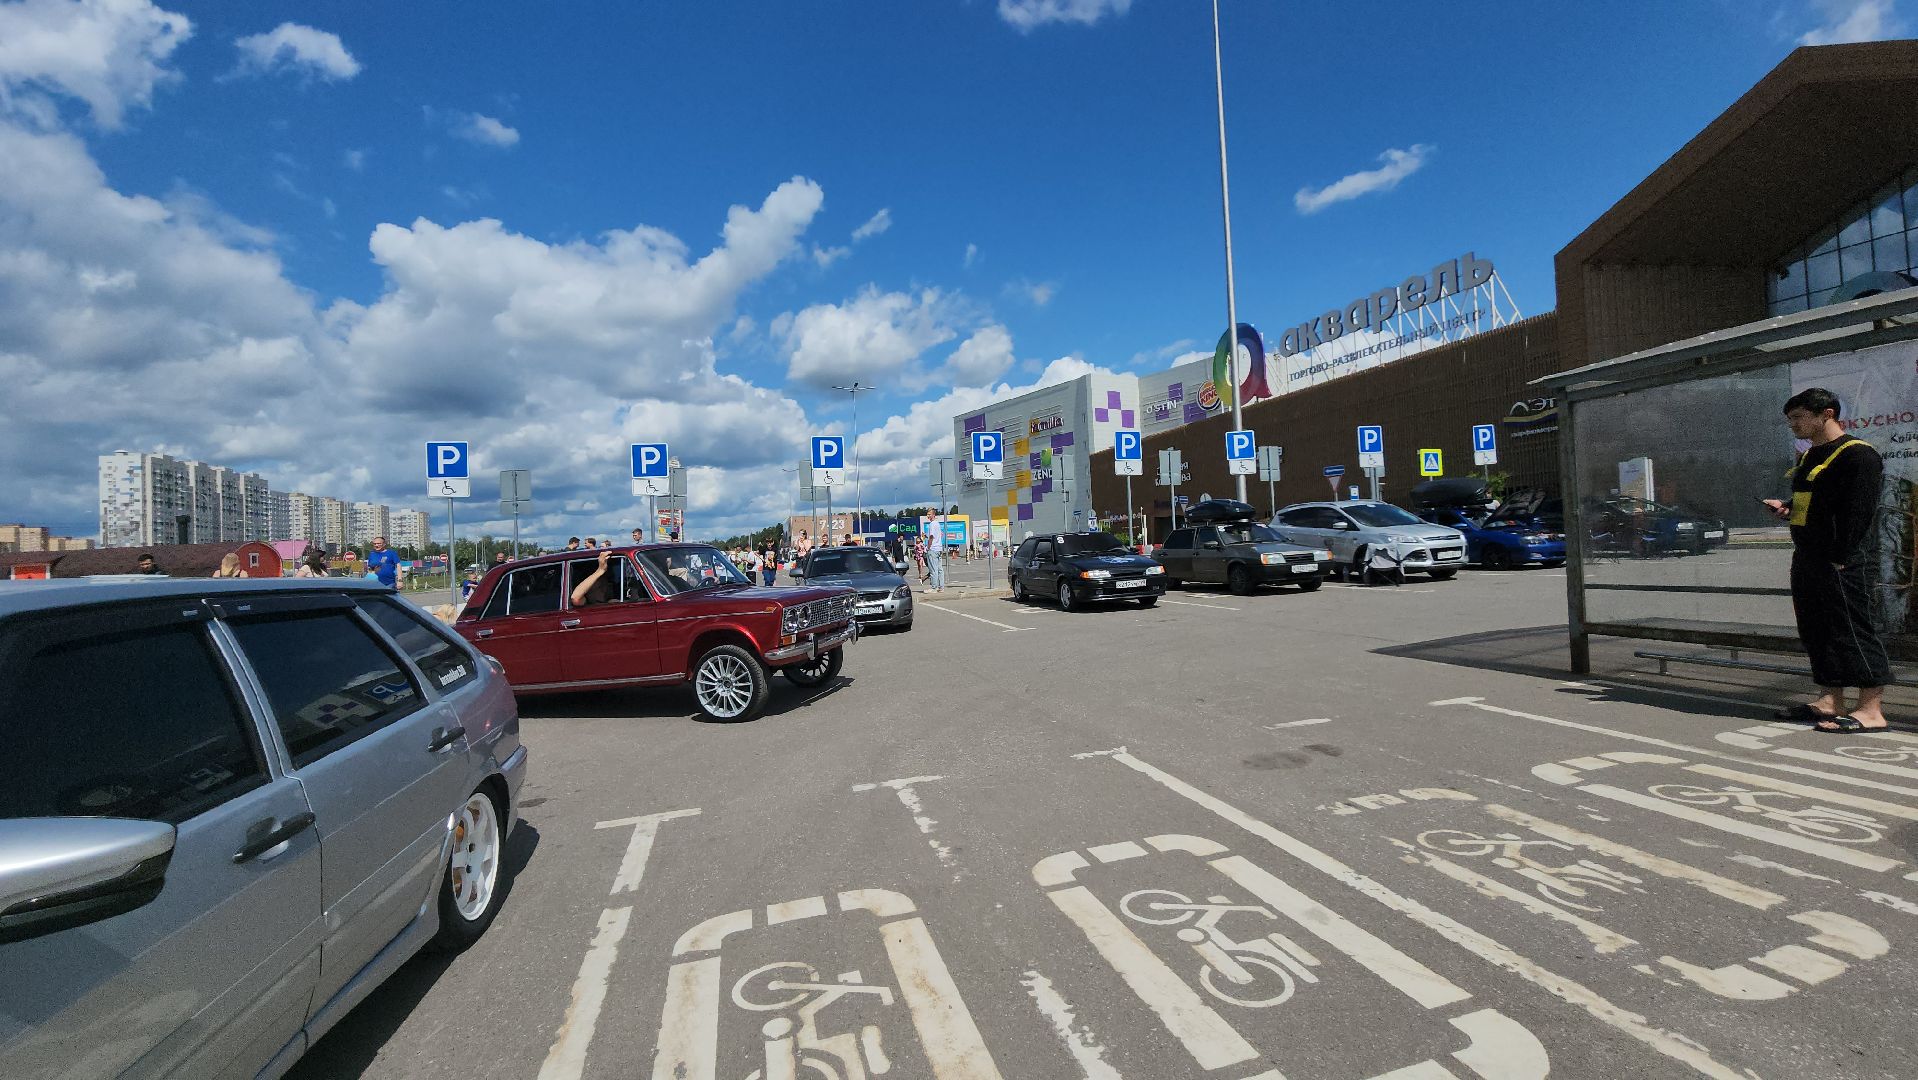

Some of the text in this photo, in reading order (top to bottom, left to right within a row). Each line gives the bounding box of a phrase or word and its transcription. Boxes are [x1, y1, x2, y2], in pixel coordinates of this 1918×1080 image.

[1279, 251, 1494, 358] акварель
[980, 435, 996, 460] P
[1121, 434, 1136, 457] P
[1233, 434, 1249, 457] P
[1364, 429, 1378, 451] P
[1478, 428, 1491, 449] P
[437, 446, 461, 474] P
[640, 447, 661, 474] P
[820, 439, 838, 466] P
